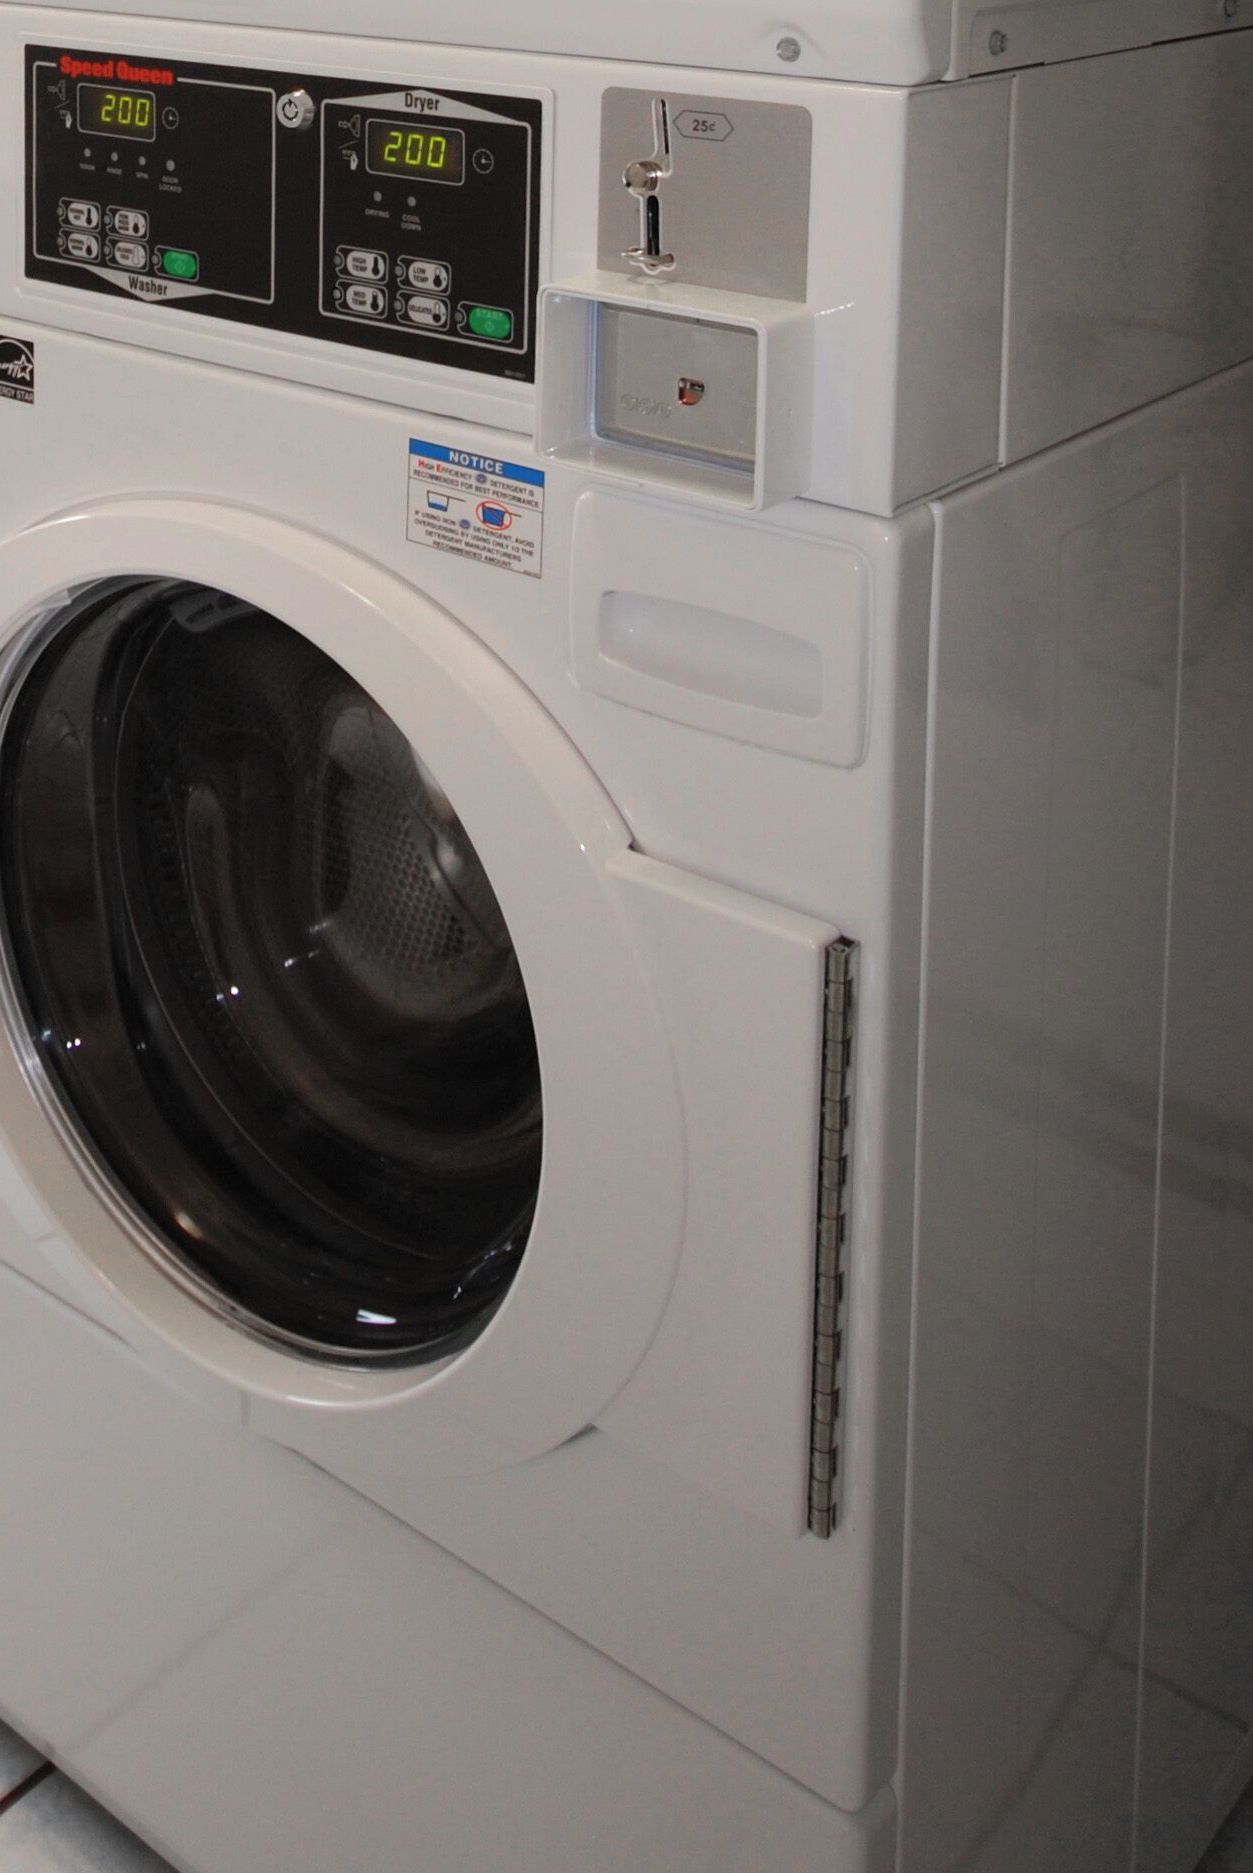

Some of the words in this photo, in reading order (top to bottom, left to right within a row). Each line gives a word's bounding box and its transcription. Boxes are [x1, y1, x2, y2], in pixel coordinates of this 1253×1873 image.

[59, 54, 114, 79] Speed
[116, 60, 174, 86] Queen
[101, 94, 150, 126] 200
[404, 92, 440, 113] Dryer
[384, 131, 446, 168] 200
[364, 208, 390, 219] DRYING
[401, 214, 421, 224] COOL
[351, 256, 367, 265] HIGH
[352, 263, 368, 273] TEMP
[413, 266, 426, 275] LOW
[128, 275, 168, 297] Washer
[412, 274, 429, 284] TEMP
[352, 297, 367, 307] TEMP
[16, 389, 34, 403] STAR
[449, 450, 504, 474] NOTICE
[413, 469, 459, 487] RECOMMENDED
[460, 481, 473, 490] FOR
[475, 484, 490, 494] BEST
[490, 479, 527, 496] DETERGENT
